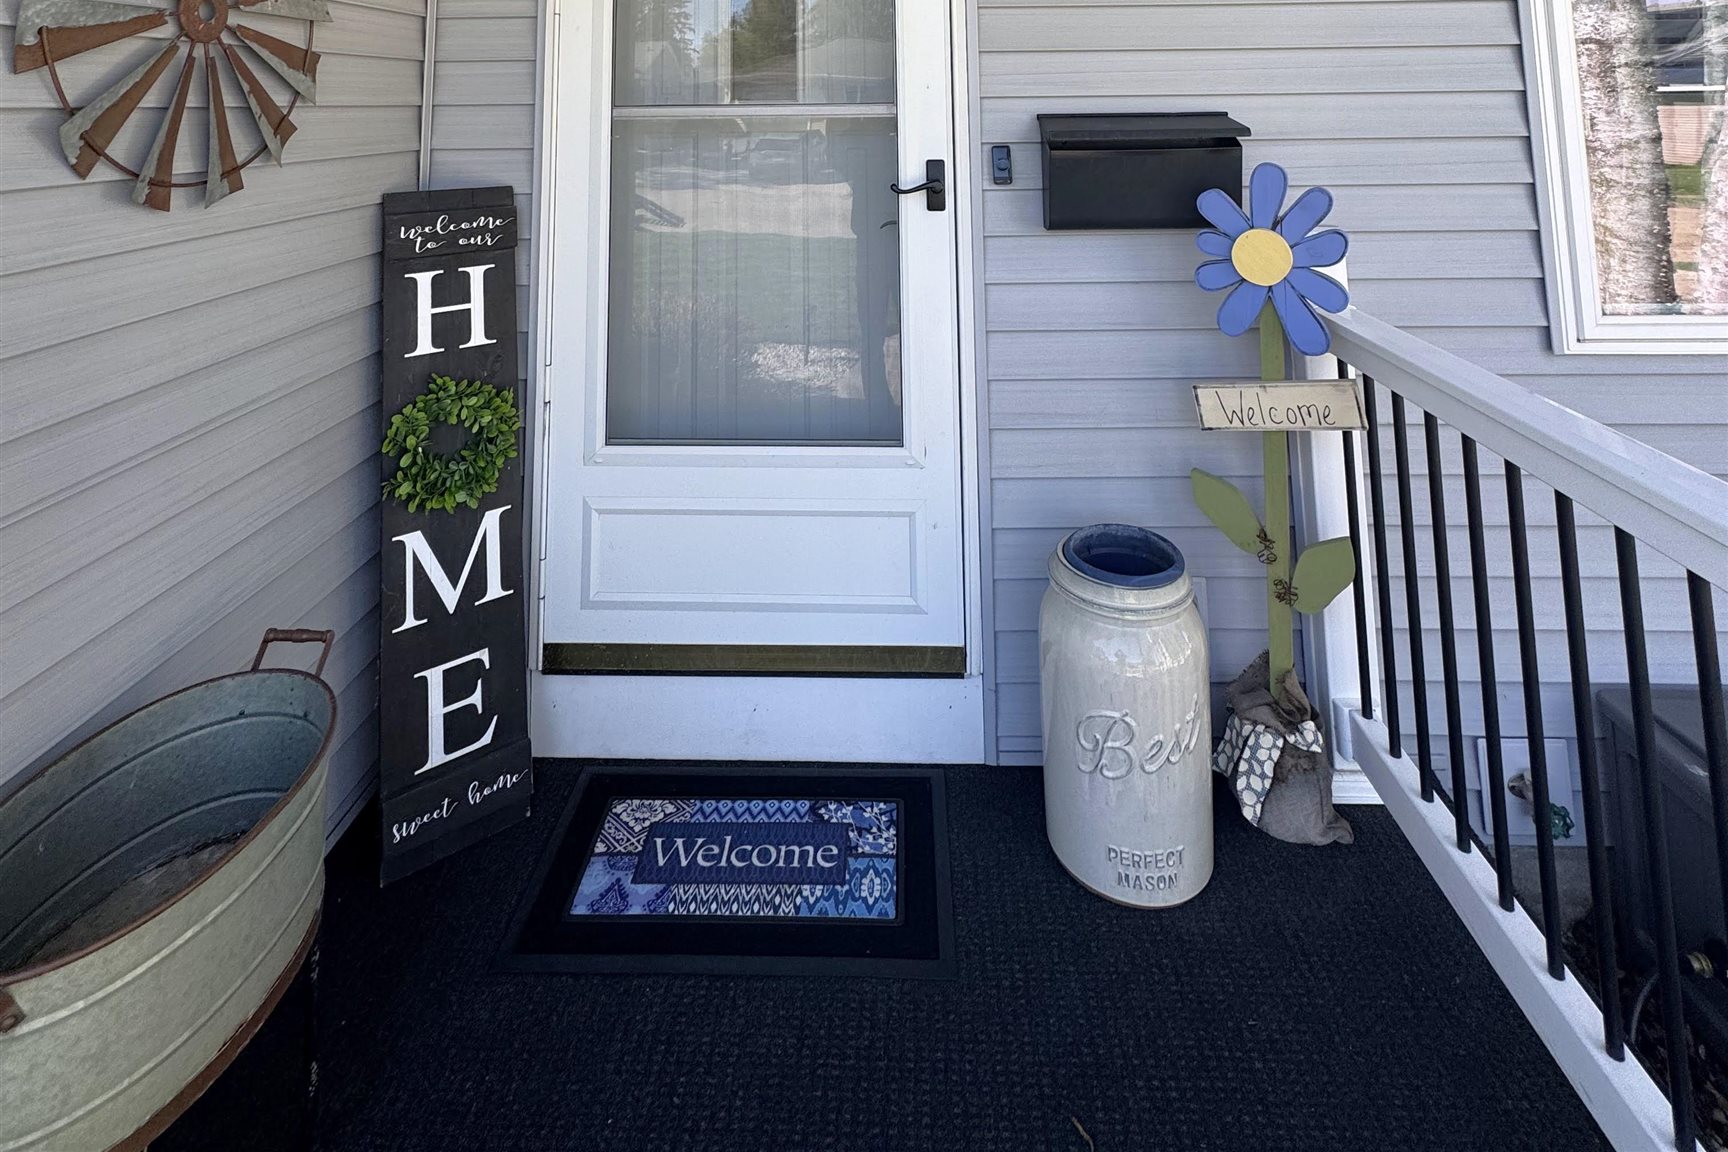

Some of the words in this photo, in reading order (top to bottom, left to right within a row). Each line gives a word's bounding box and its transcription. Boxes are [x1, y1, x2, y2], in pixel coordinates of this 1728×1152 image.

[400, 215, 514, 239] welcome
[416, 236, 447, 254] to
[458, 233, 504, 246] our
[1215, 390, 1337, 427] Welcome
[393, 797, 459, 844] sweet
[467, 768, 528, 805] home
[653, 835, 840, 869] Welcome
[1108, 845, 1186, 870] PERFECT
[1117, 872, 1178, 891] MASON
